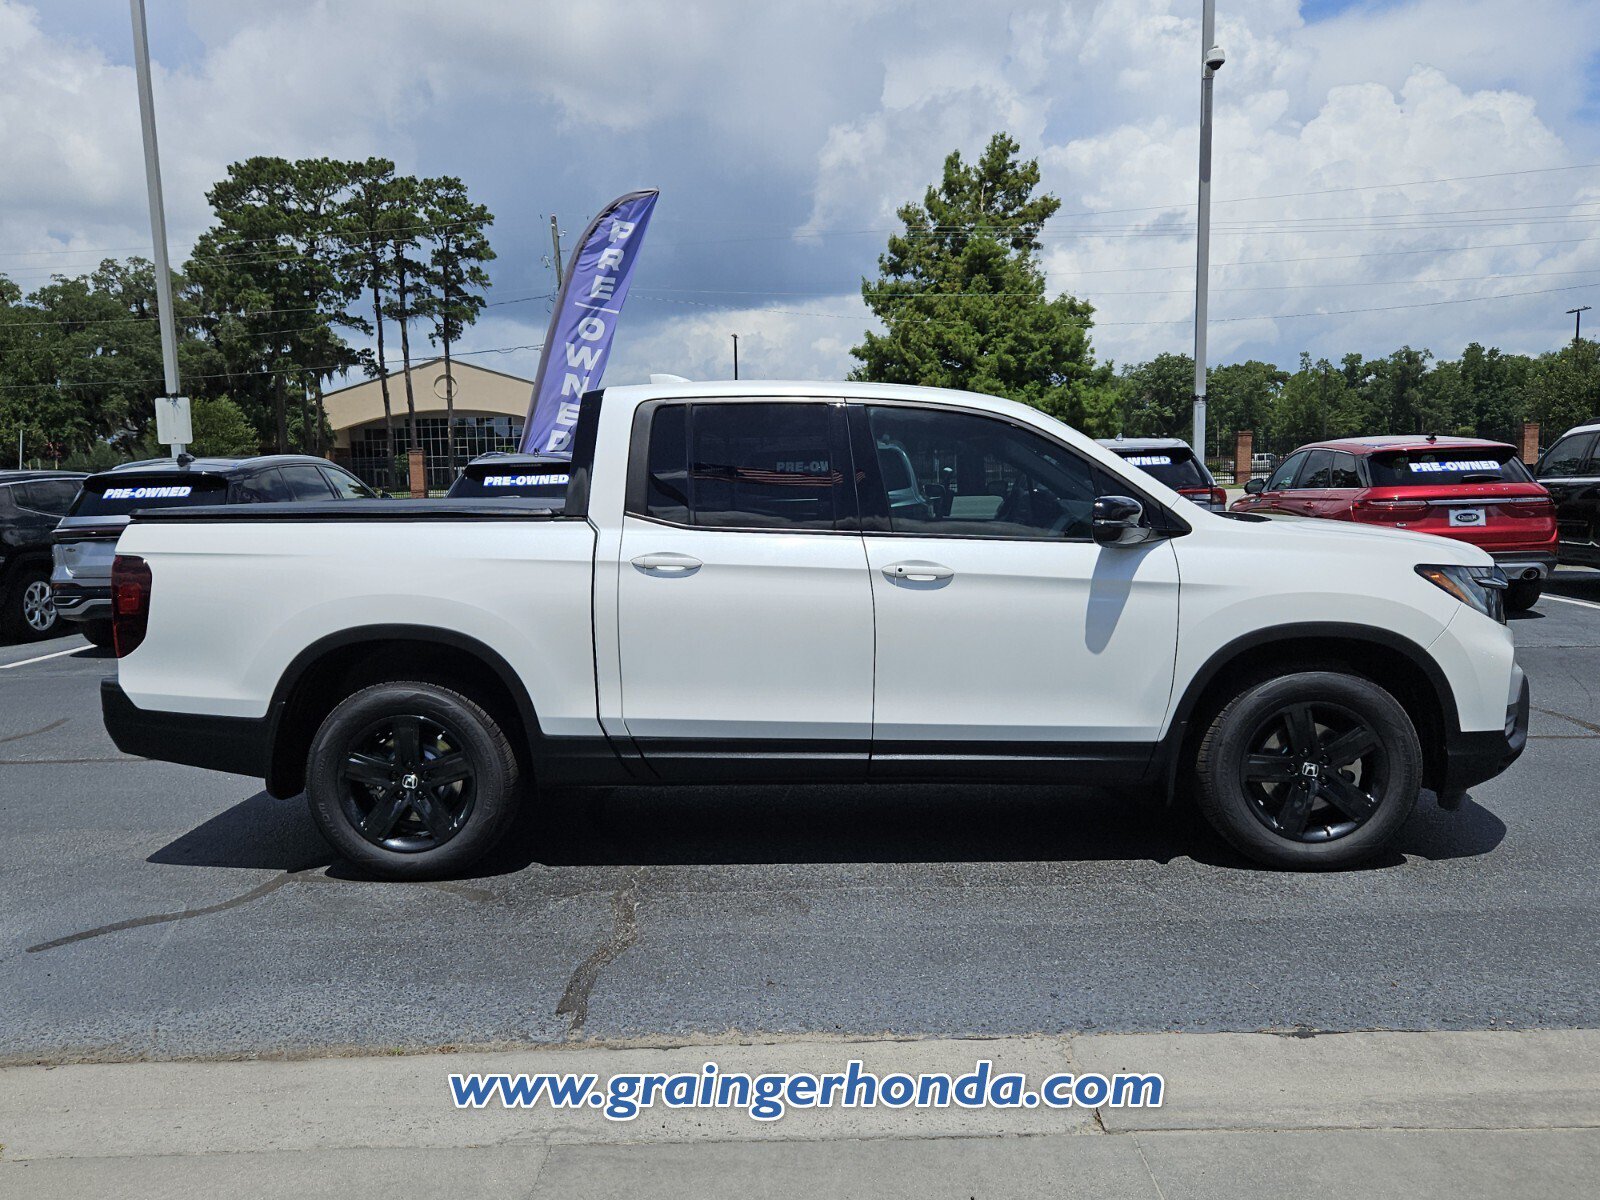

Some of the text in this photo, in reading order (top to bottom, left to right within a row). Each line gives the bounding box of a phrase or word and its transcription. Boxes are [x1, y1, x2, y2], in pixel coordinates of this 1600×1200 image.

[1408, 460, 1501, 473] PRE-OWNED
[483, 474, 570, 487] PRE-OWNED
[102, 486, 192, 499] PRE-OWNED
